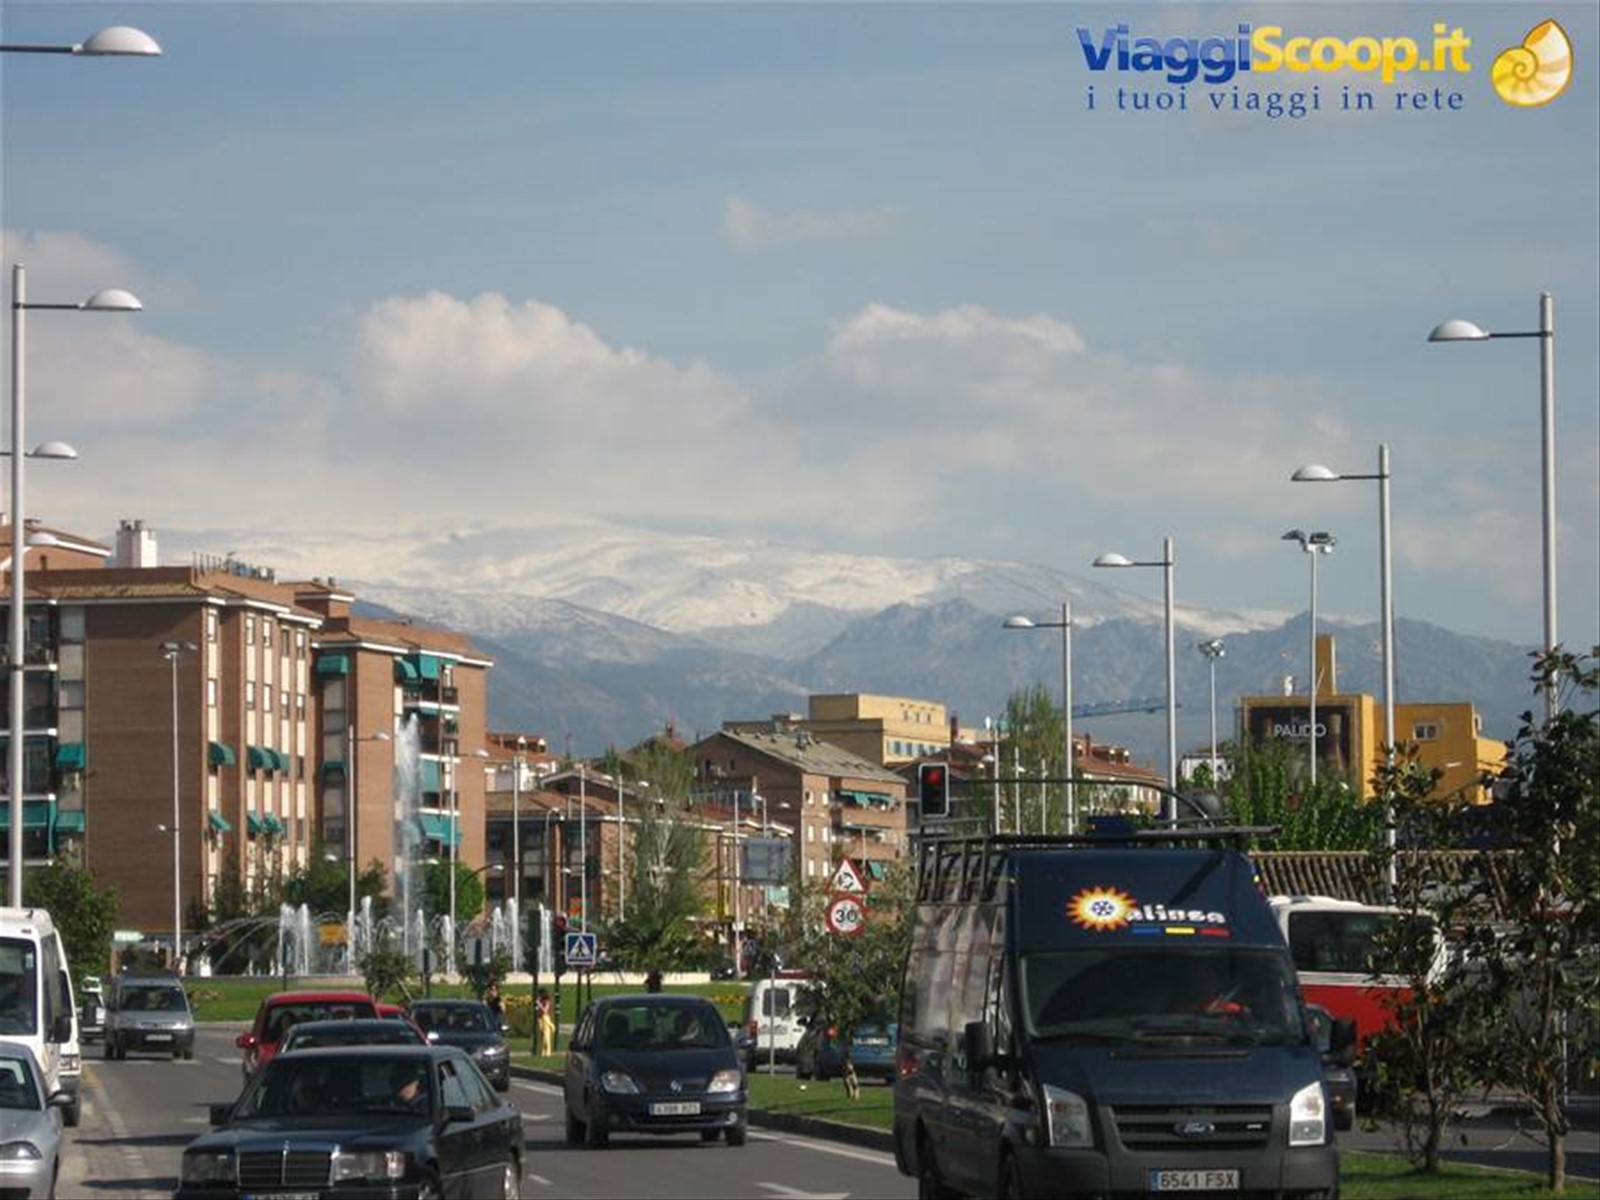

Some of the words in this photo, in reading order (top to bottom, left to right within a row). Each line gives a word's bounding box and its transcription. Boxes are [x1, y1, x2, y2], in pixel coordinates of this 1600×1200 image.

[835, 909, 858, 923] 30
[1160, 1172, 1200, 1188] 6541
[1204, 1172, 1235, 1187] FSX
